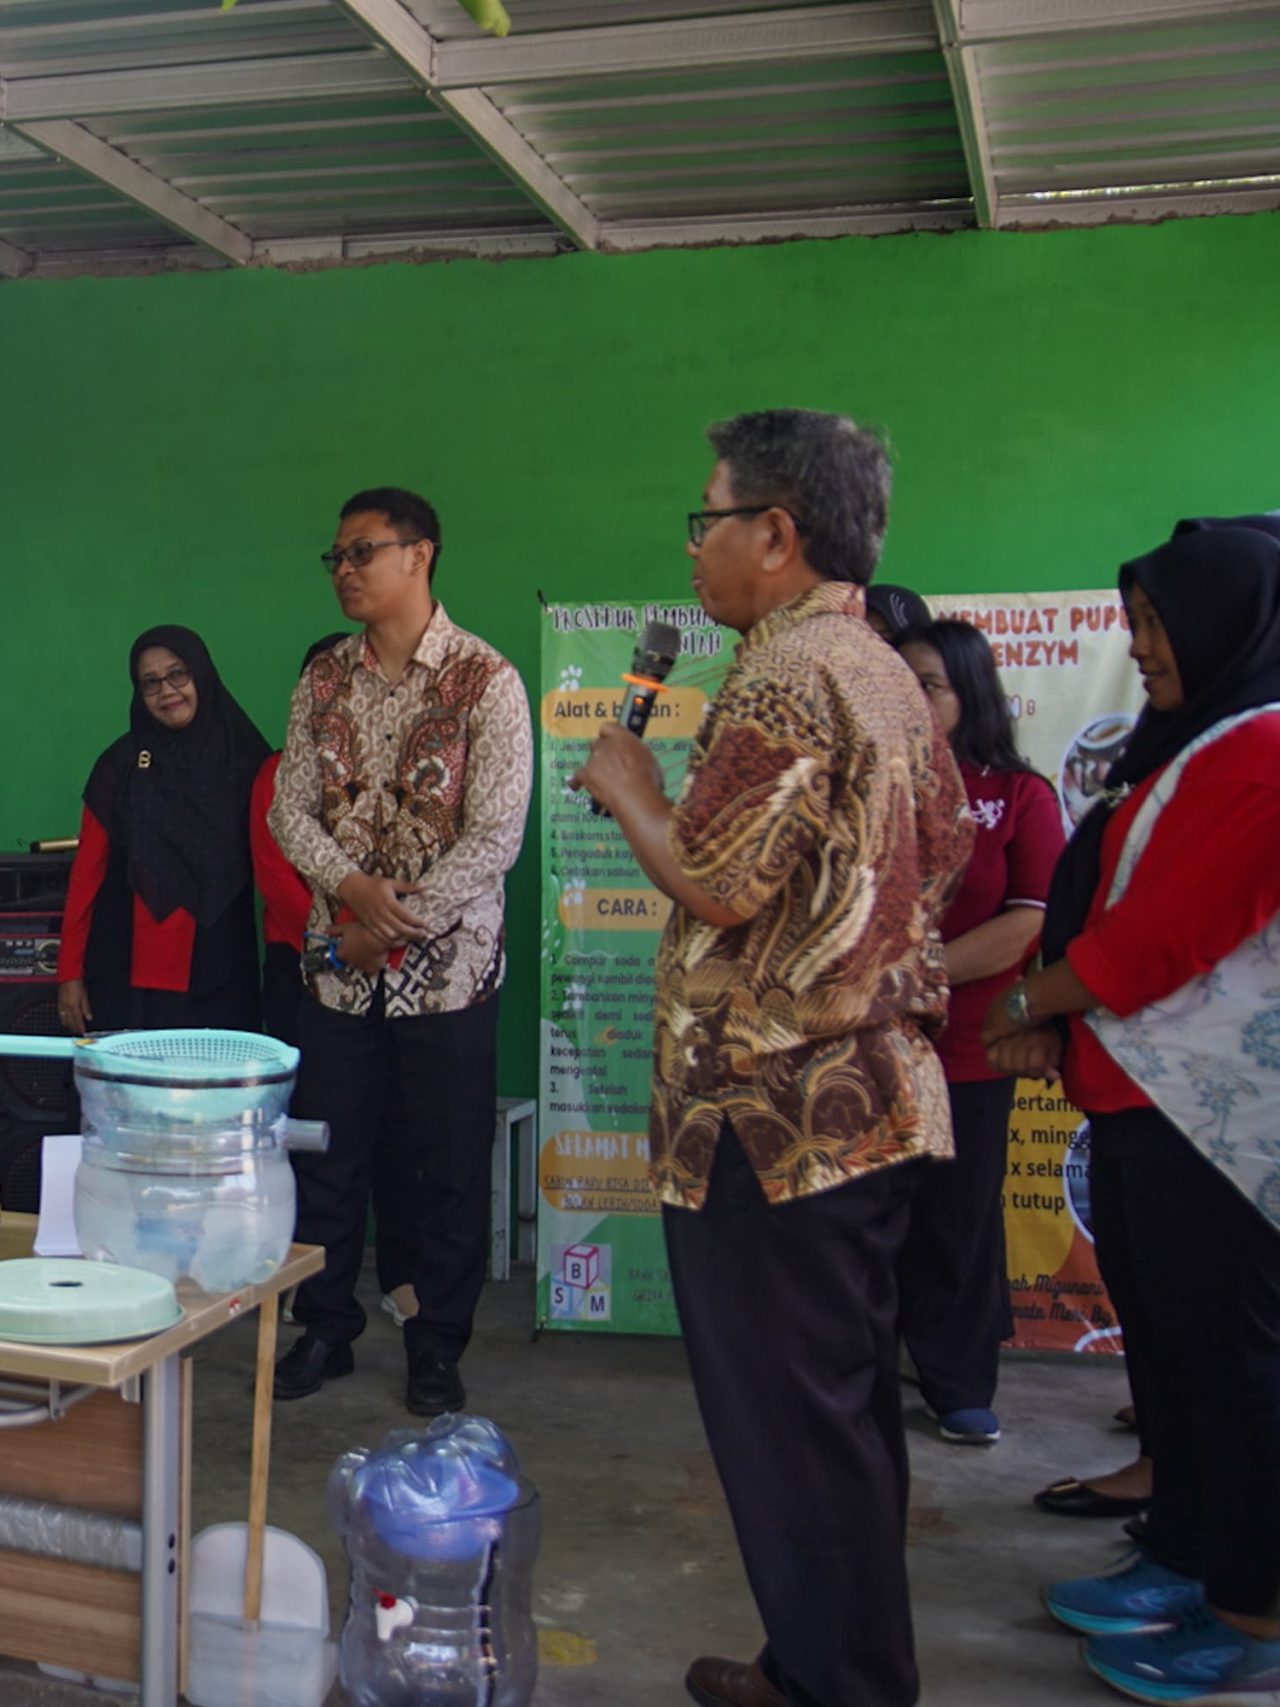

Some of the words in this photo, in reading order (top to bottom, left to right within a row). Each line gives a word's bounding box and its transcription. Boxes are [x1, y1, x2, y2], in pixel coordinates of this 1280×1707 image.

[554, 605, 638, 631] PROSEDUR
[554, 702, 591, 718] Alat
[594, 702, 607, 718] &
[597, 898, 648, 916] CARA
[555, 1134, 630, 1160] SELAMAT
[1012, 1192, 1066, 1215] tutup
[572, 1263, 581, 1279] B
[555, 1287, 564, 1303] S
[591, 1296, 605, 1311] M
